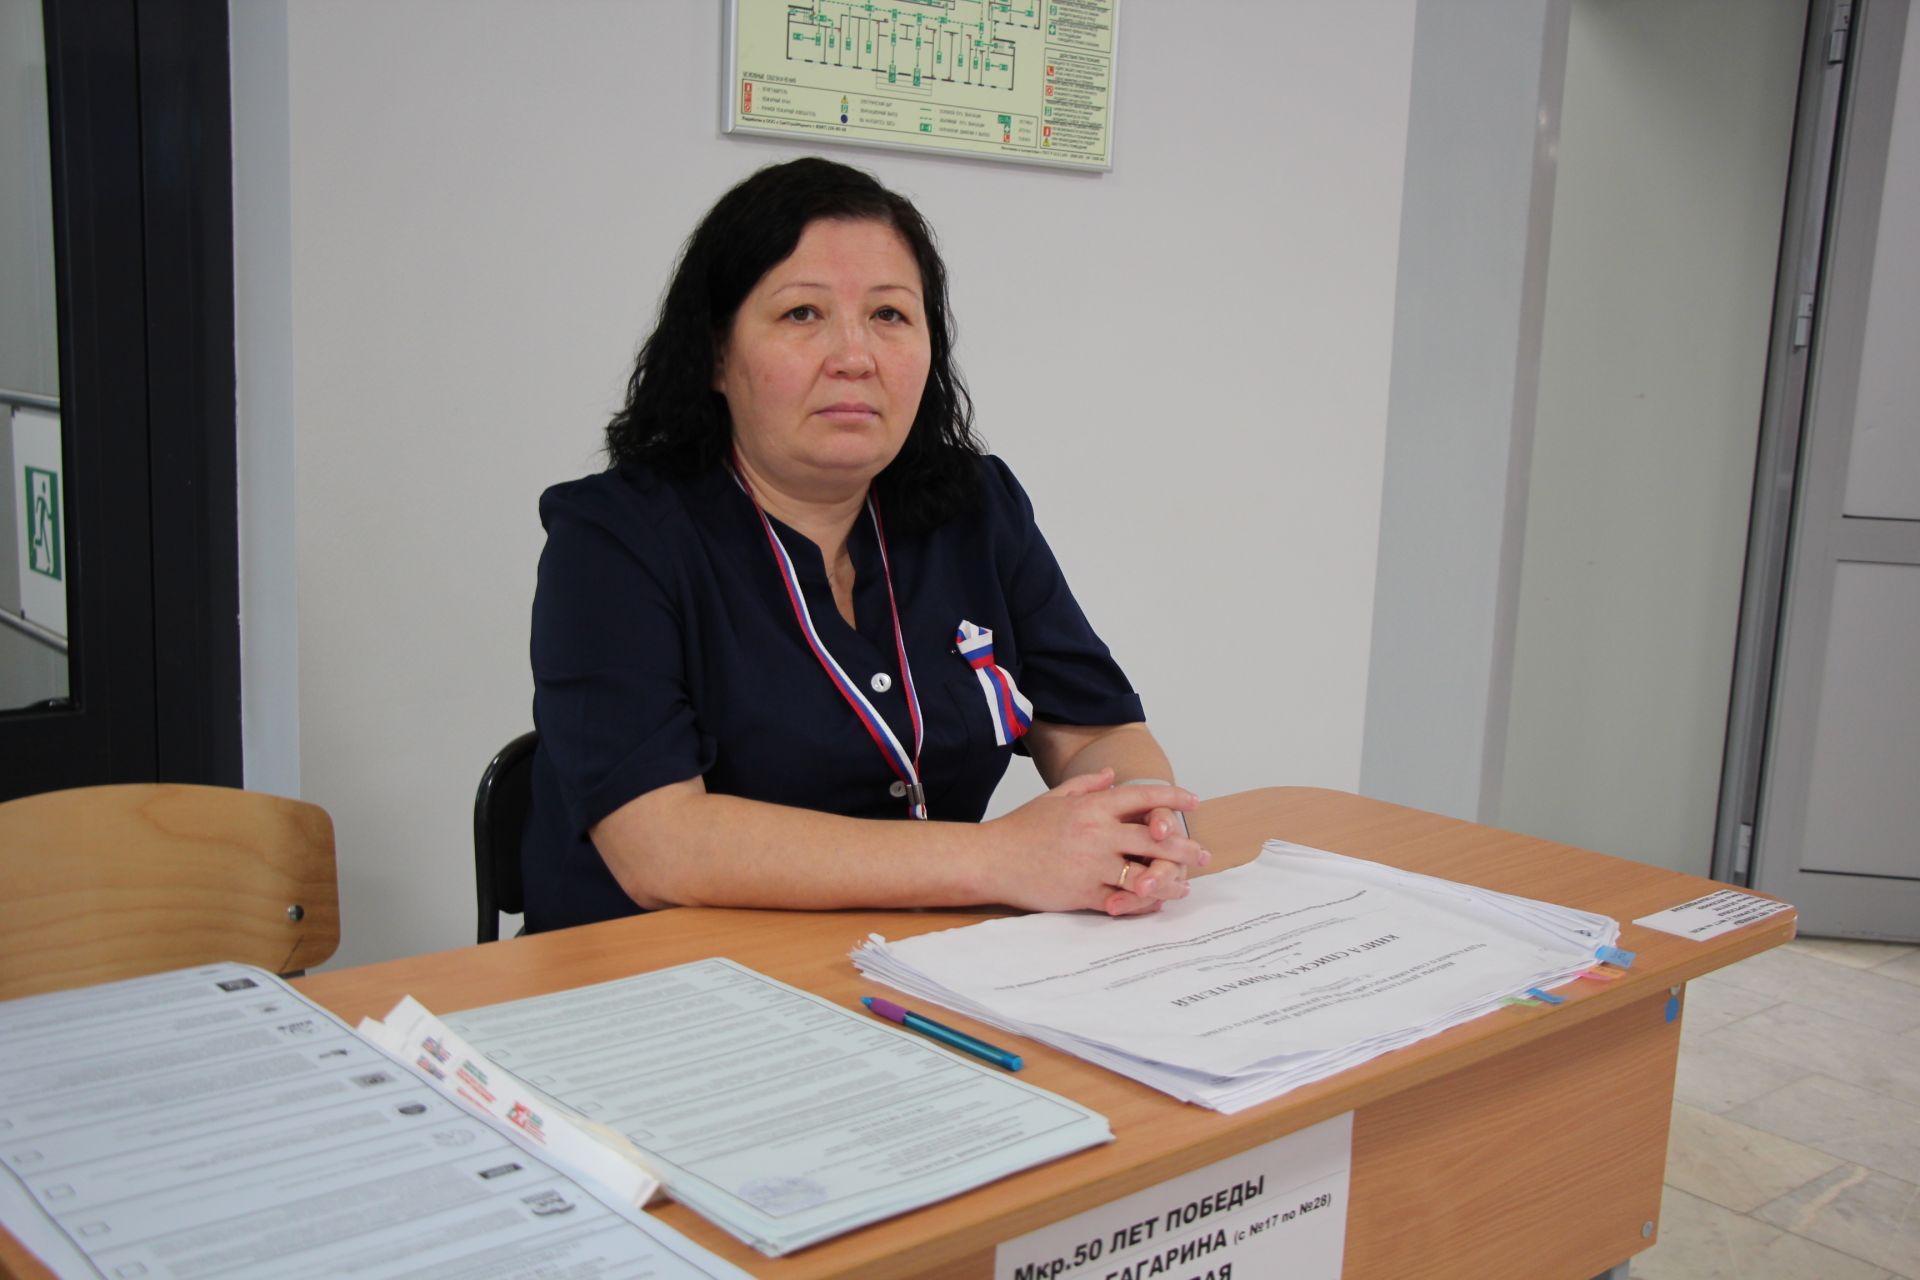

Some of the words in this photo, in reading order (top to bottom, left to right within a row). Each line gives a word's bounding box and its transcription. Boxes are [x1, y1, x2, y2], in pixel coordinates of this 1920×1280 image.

[1346, 933, 1400, 954] КНИГА
[1285, 951, 1350, 975] СПИСКА
[1170, 972, 1288, 1007] ИЗБИРАТЕЛЕЙ
[1109, 1215, 1160, 1254] ЛЕТ
[1165, 1174, 1265, 1232] ПОБЕДЫ
[1249, 1213, 1278, 1237] №17
[1281, 1208, 1297, 1223] по
[1298, 1192, 1332, 1215] №28)
